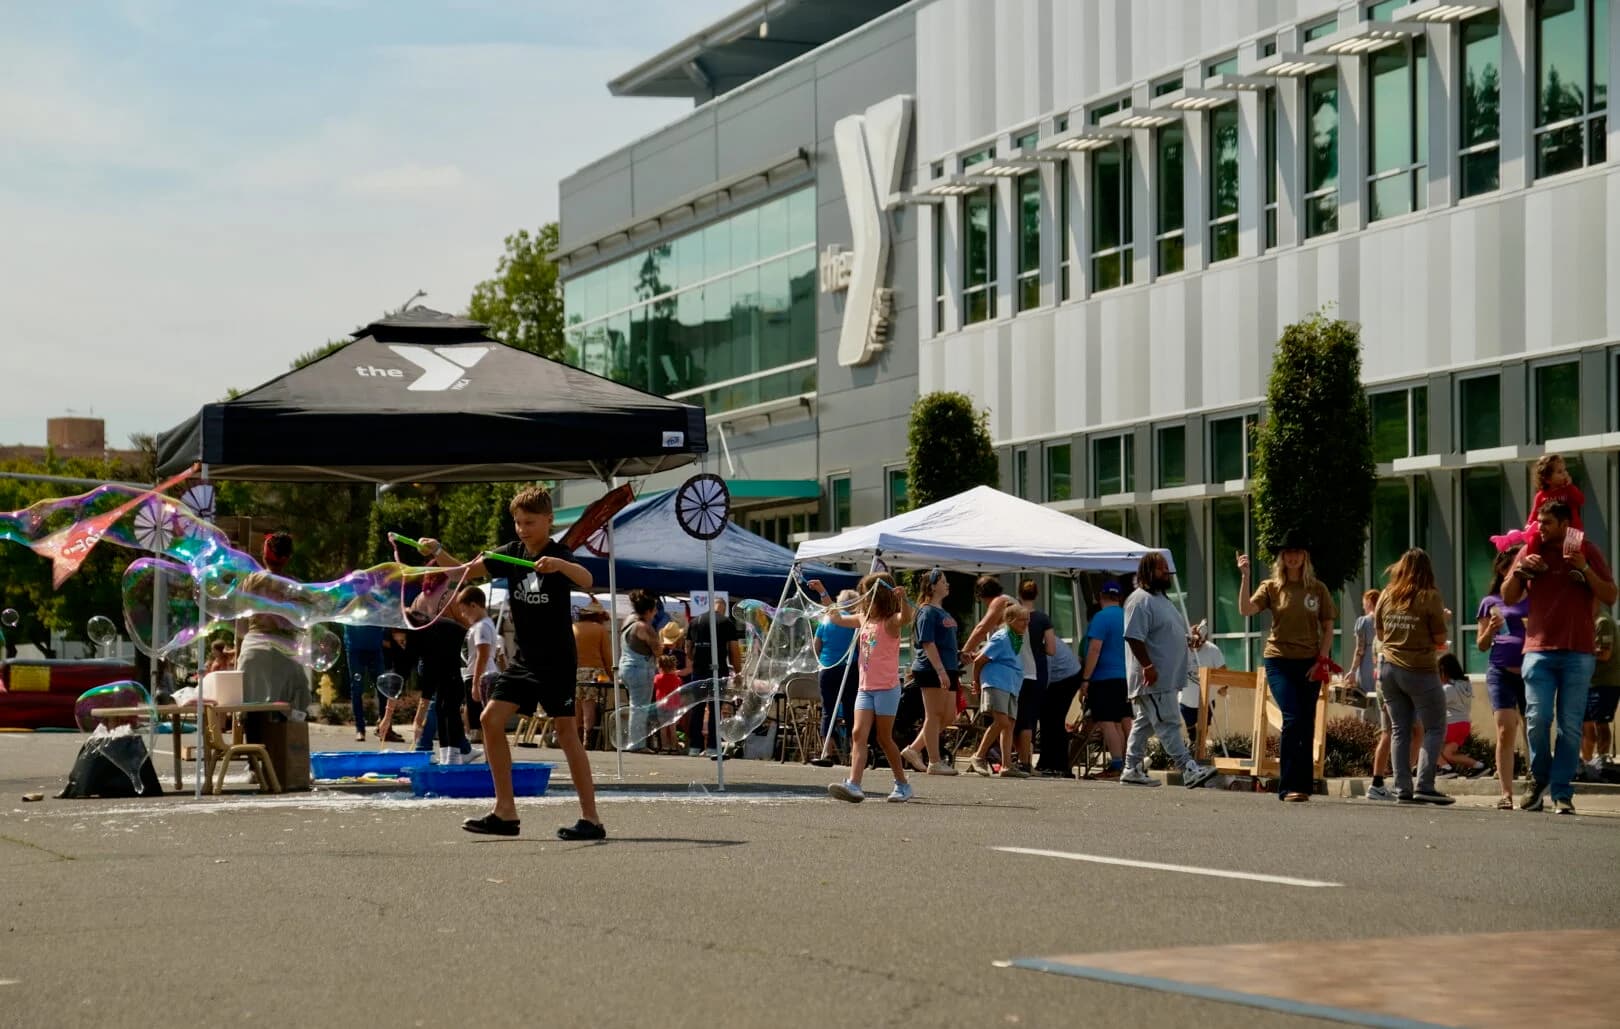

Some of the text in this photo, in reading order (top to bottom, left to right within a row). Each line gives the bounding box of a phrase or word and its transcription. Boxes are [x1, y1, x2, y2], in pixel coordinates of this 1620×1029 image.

[834, 94, 912, 366] Y
[355, 345, 489, 391] the Y
